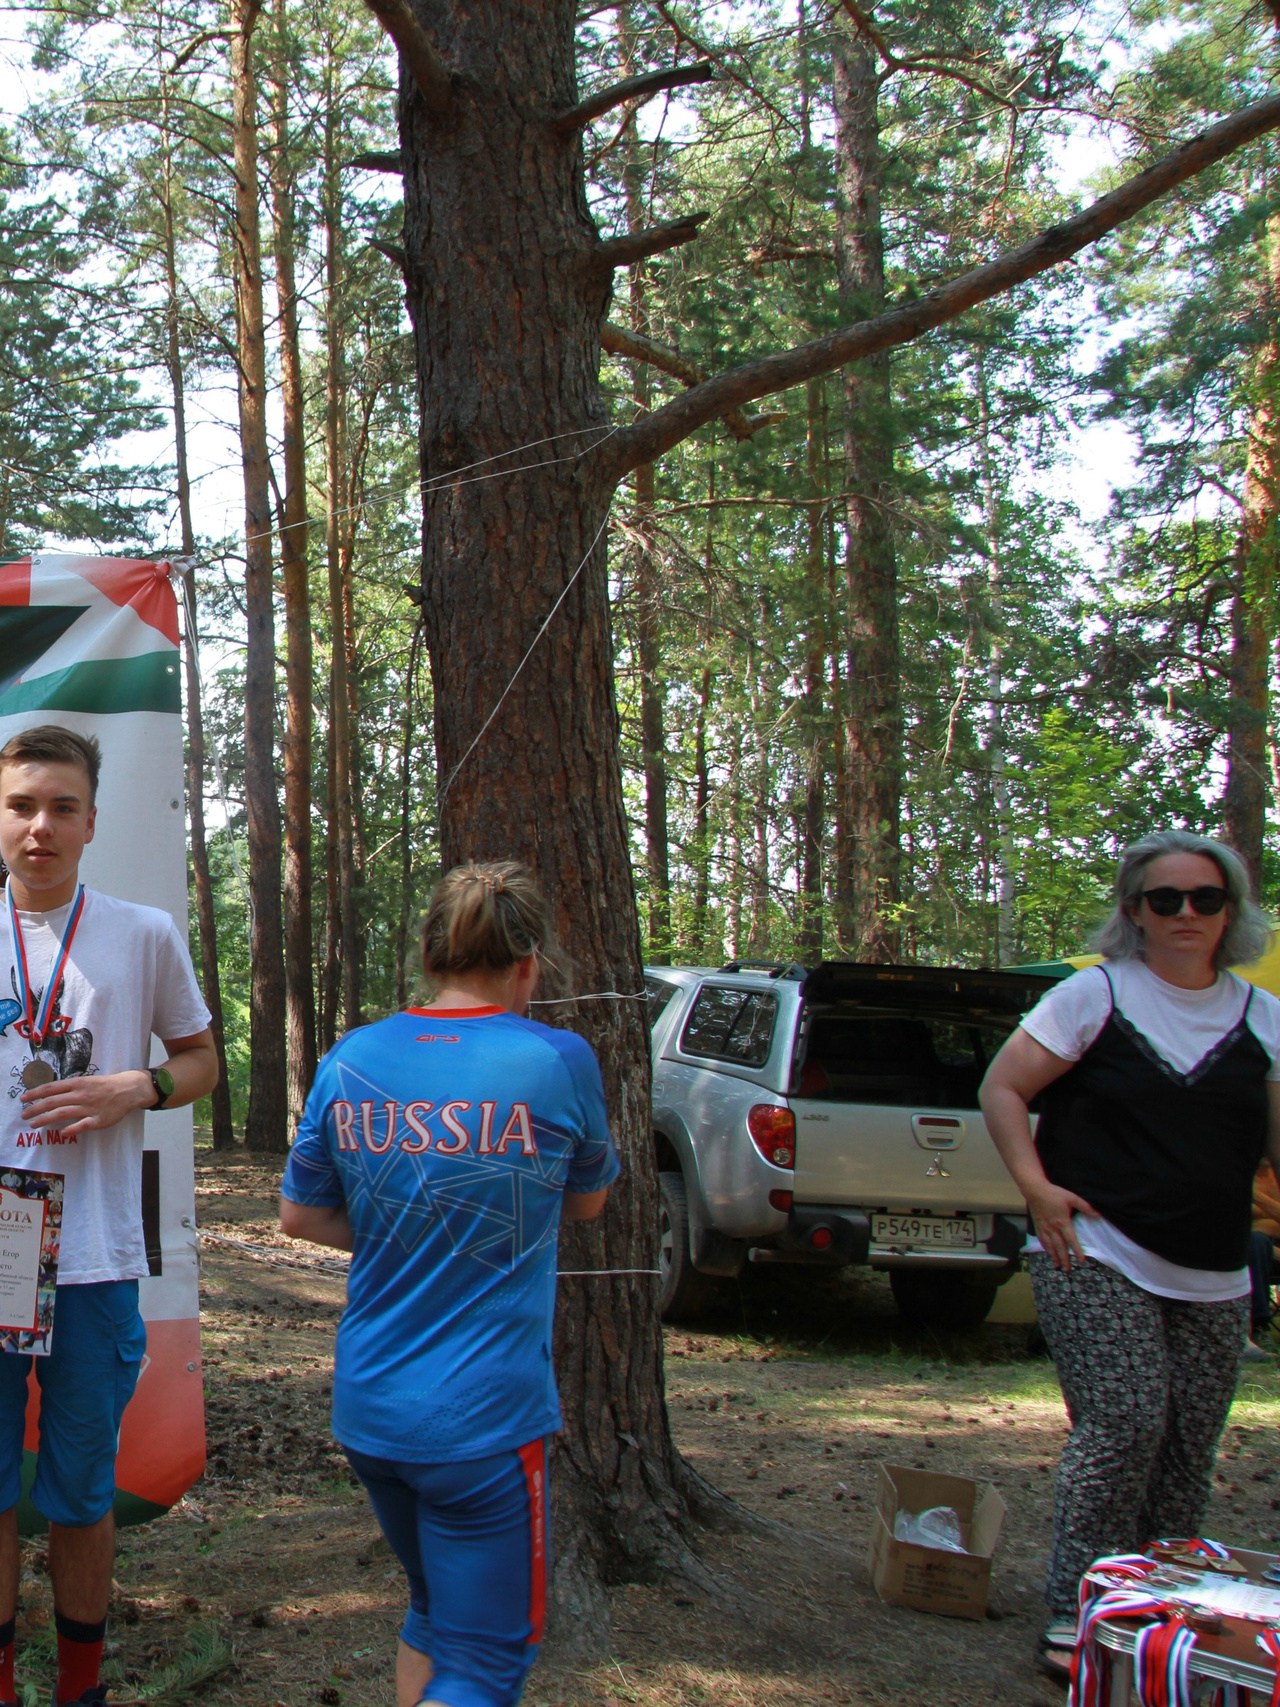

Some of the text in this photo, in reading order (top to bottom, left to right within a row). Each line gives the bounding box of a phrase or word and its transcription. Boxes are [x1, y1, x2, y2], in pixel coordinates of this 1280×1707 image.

[0, 1002, 11, 1010] me
[7, 1007, 18, 1017] sea
[333, 1100, 538, 1156] RUSSIA
[946, 1221, 971, 1236] 174
[2, 1250, 20, 1259] Егор
